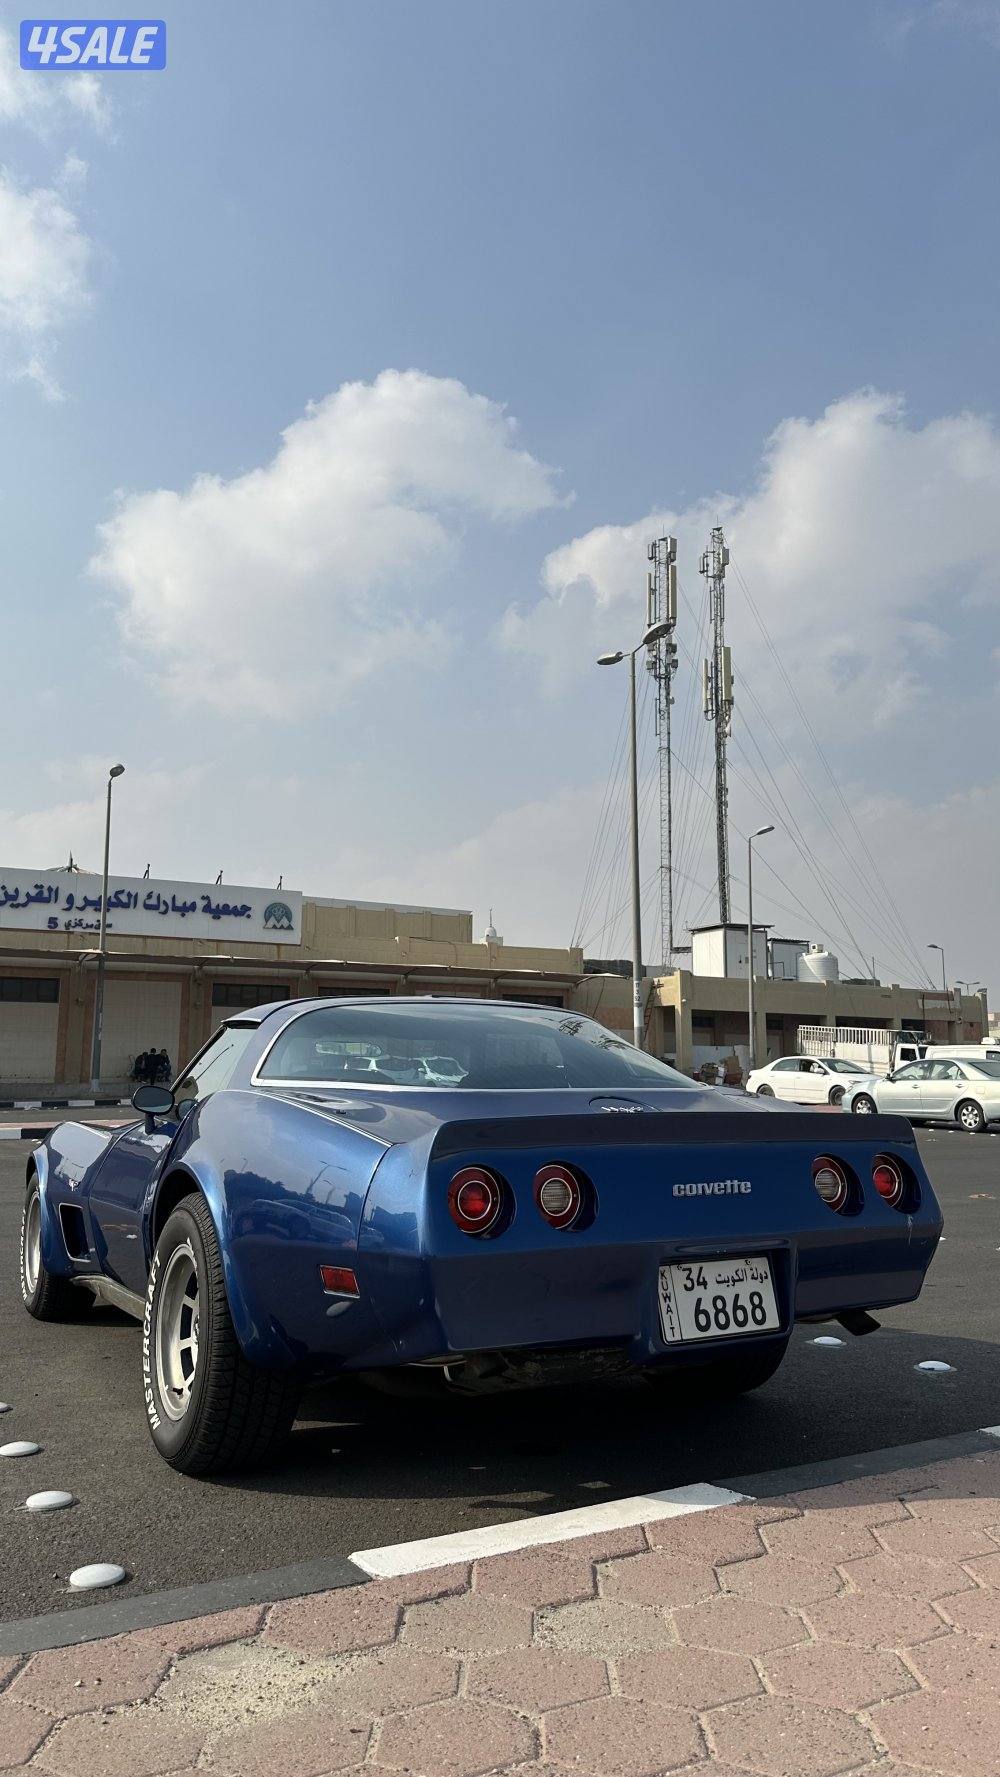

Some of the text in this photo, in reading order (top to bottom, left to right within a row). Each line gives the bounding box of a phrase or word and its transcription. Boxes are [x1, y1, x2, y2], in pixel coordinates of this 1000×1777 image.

[143, 890, 197, 915] مبارك
[201, 894, 252, 920] جمعية
[47, 916, 59, 929] 5
[672, 1179, 752, 1197] corvette
[681, 1266, 708, 1292] 34
[715, 1267, 769, 1288] دولة الكويت
[660, 1269, 676, 1338] KUWAIT
[694, 1291, 767, 1333] 6868
[142, 1249, 161, 1430] MASTERCRAFT
